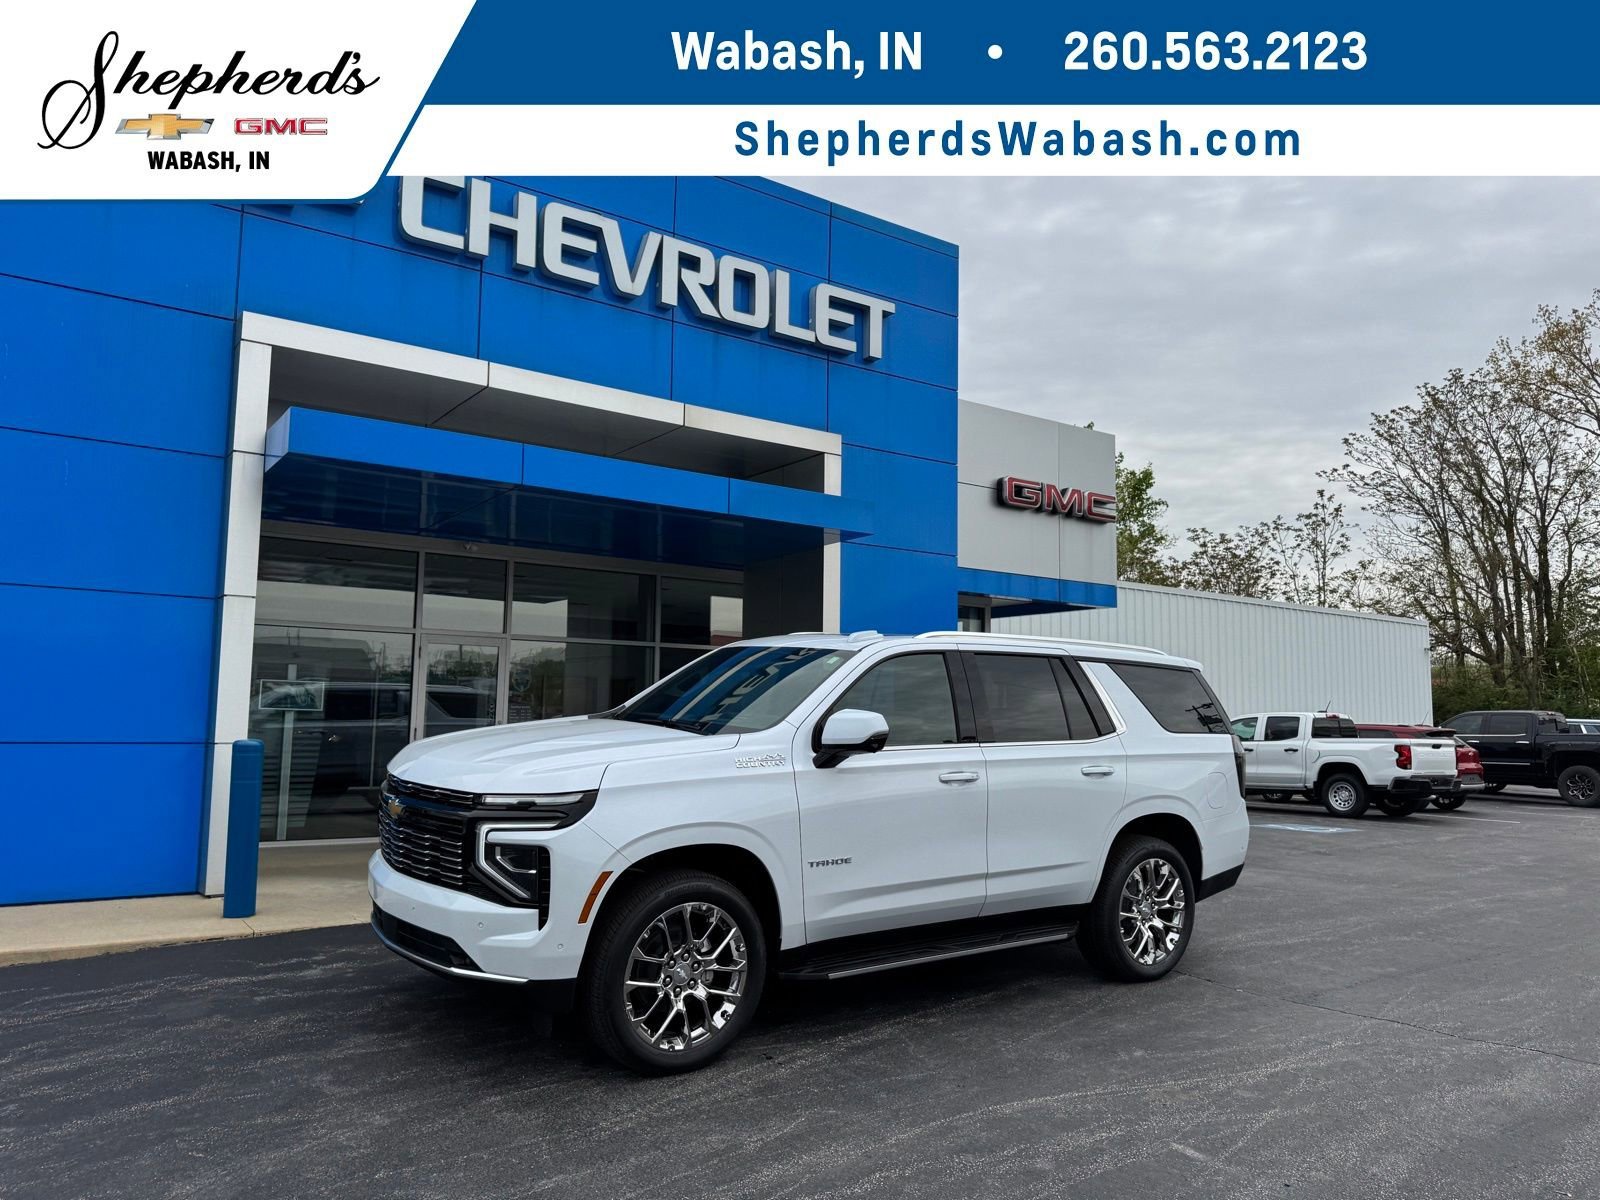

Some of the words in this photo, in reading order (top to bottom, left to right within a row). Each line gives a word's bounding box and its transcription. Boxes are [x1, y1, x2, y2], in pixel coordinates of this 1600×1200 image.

[398, 176, 897, 363] CHEVROLET
[1002, 474, 1117, 523] GMC
[735, 760, 786, 769] COUNTRY
[808, 857, 853, 868] TAHOE
